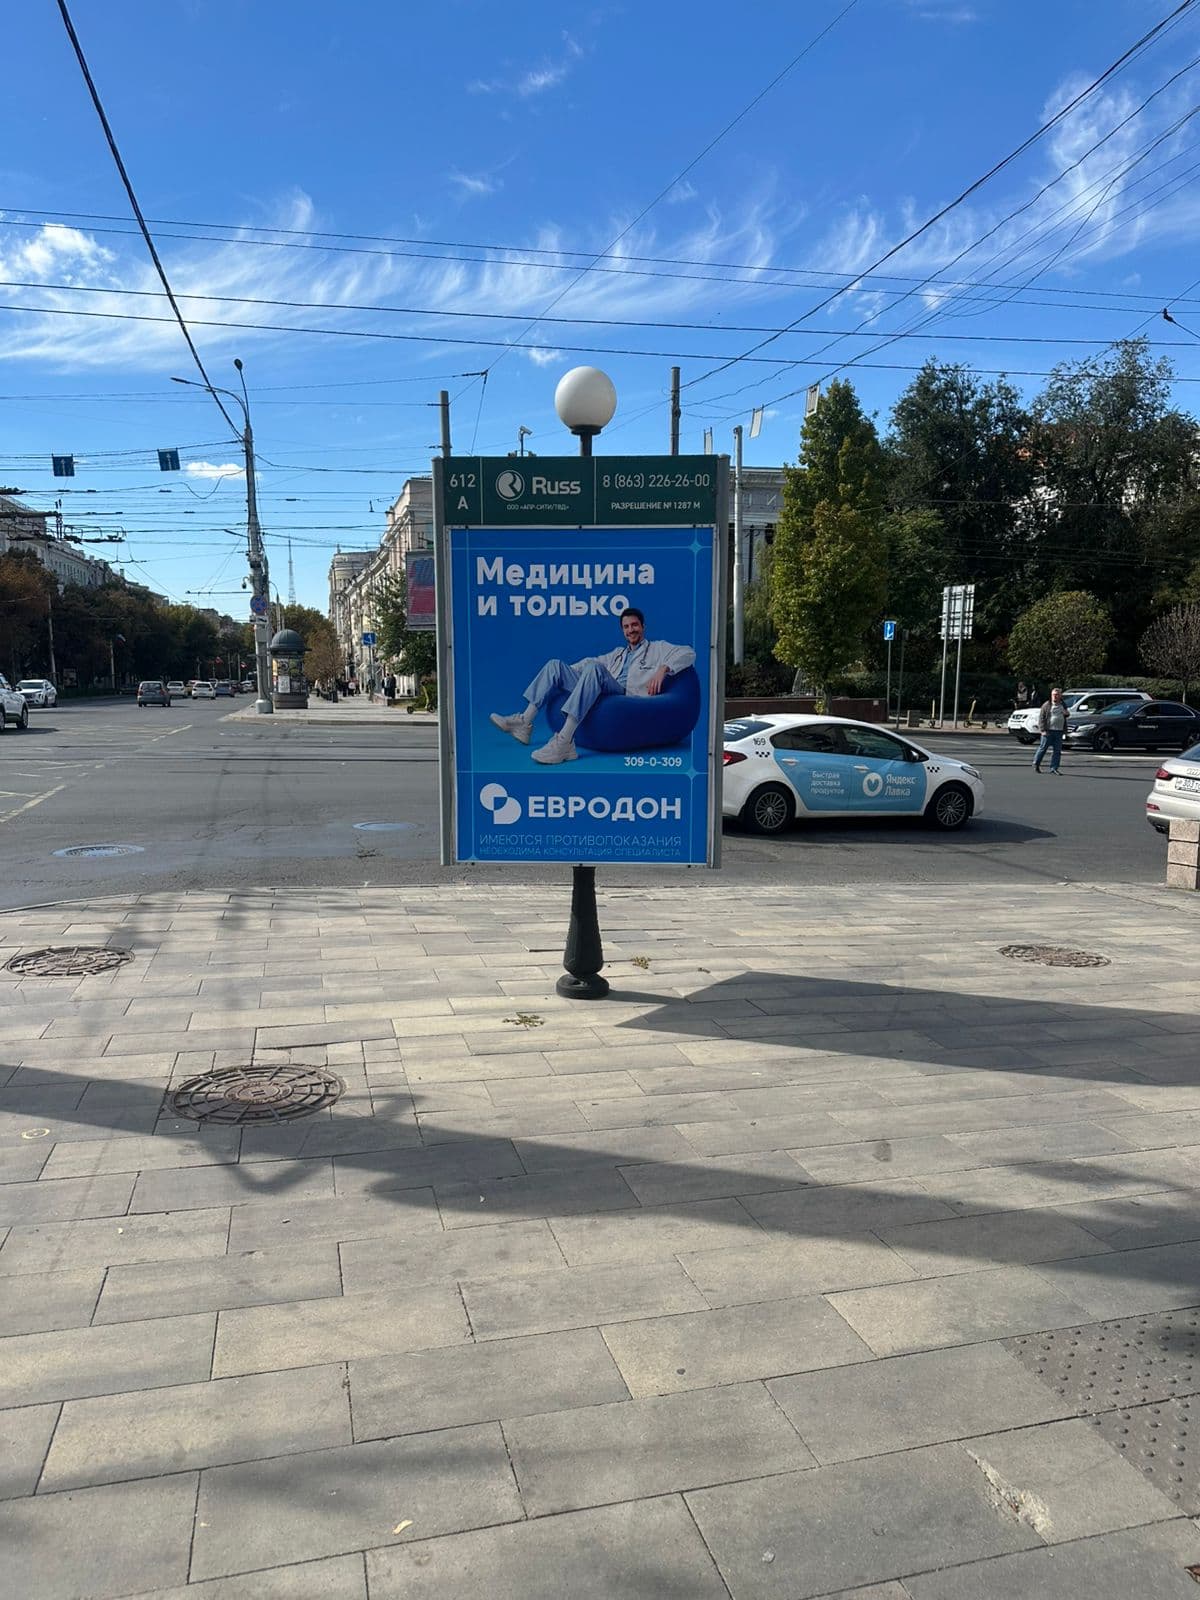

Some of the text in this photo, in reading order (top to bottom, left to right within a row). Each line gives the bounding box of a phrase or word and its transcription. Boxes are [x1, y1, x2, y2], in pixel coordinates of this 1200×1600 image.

[449, 474, 476, 487] 612
[532, 477, 582, 495] Russ
[602, 473, 711, 489] 8 (863) 226-26-00
[611, 501, 662, 510] РАЗРЕШЕНИЕ
[663, 502, 672, 510] №
[674, 501, 691, 510] 1287
[476, 556, 655, 589] Медицина
[477, 594, 630, 617] и только
[624, 757, 683, 768] 309-0-309
[812, 770, 841, 779] Быстрая
[885, 775, 917, 786] Яндекс
[810, 780, 841, 788] доставка
[884, 787, 911, 796] Лавка
[528, 795, 682, 822] ЕВРОДОН
[479, 834, 681, 847] ИМЕЮТСЯ ПРОТИВОПОКАЗАНИЯ
